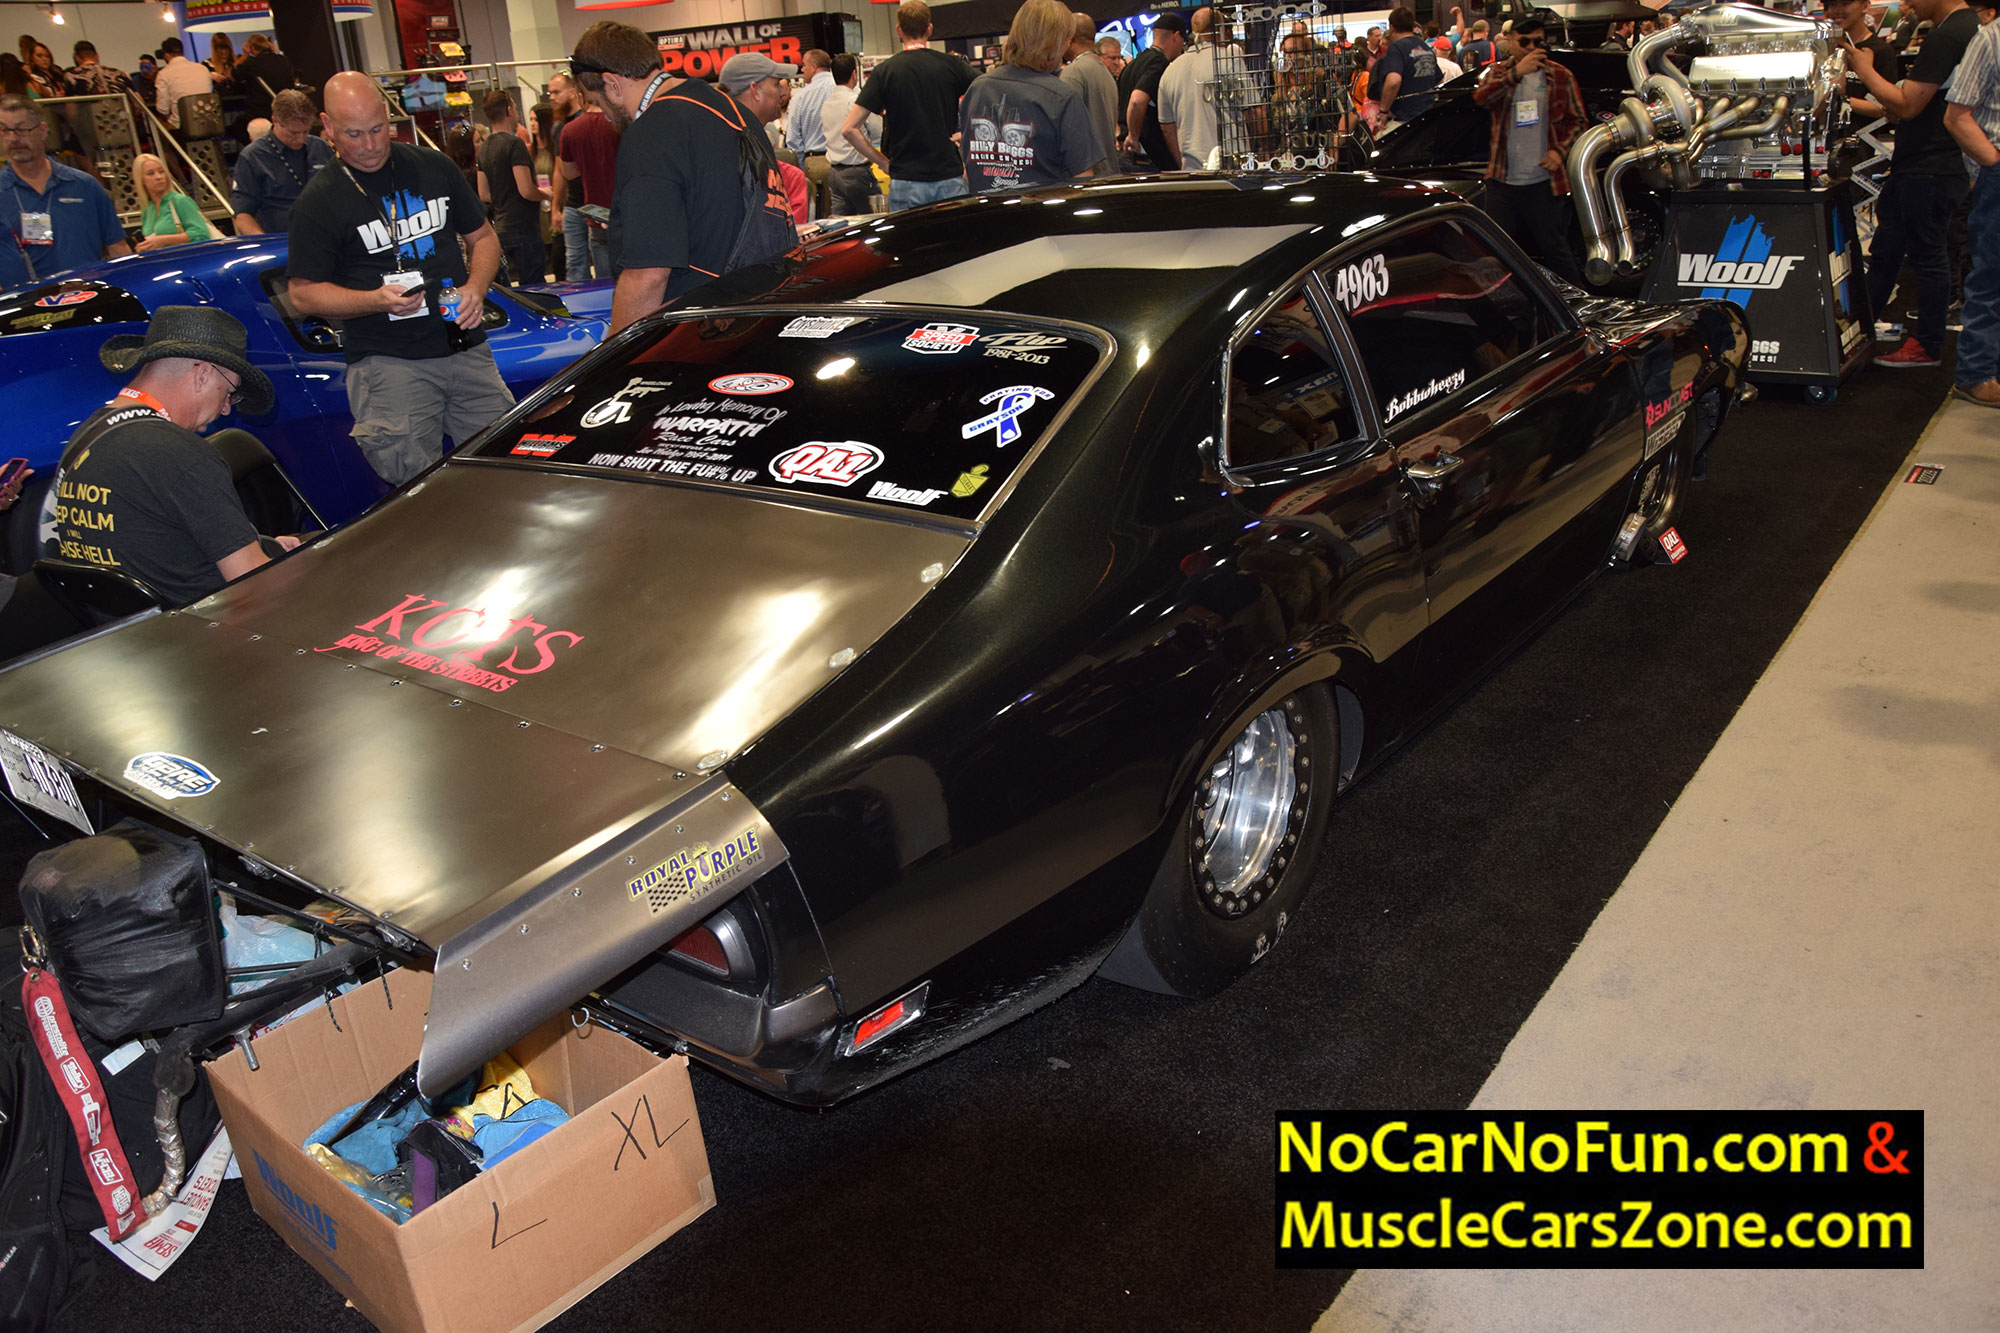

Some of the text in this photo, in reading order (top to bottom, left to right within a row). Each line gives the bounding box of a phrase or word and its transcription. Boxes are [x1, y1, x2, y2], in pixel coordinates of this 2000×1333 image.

[187, 2, 269, 17] DISTRIBUTIN
[659, 35, 684, 45] OPTIMA
[686, 23, 782, 51] WALL OF
[1336, 253, 1390, 312] 4983
[1677, 253, 1805, 290] Woolf
[909, 338, 962, 351] SOCIETY
[920, 331, 966, 343] SPEED
[1752, 340, 1780, 354] GGS
[983, 348, 1051, 364] 1981-2013
[1752, 355, 1777, 363] NES!
[669, 397, 716, 414] Loving
[711, 397, 766, 420] Memory
[969, 404, 1024, 432] GRAYSON
[652, 415, 767, 438] WARPATH
[653, 431, 737, 446] Race Cars
[587, 453, 618, 467] NOW
[620, 455, 662, 473] SHUT
[659, 459, 689, 475] THE
[731, 469, 758, 483] UP
[780, 445, 873, 482] QA1
[59, 481, 75, 499] ILL
[76, 482, 112, 505] NOT
[866, 481, 949, 506] Woolf
[56, 505, 114, 532] EP CALM
[60, 541, 121, 566] AISE HELL
[684, 827, 761, 892] PURPLE
[629, 849, 691, 899] ROYAL
[689, 852, 763, 901] SYNTHETIC OIL
[611, 1093, 690, 1171] XL
[251, 1148, 339, 1252] Woolf
[491, 1201, 548, 1250] L
[143, 1236, 180, 1259] SEMA
